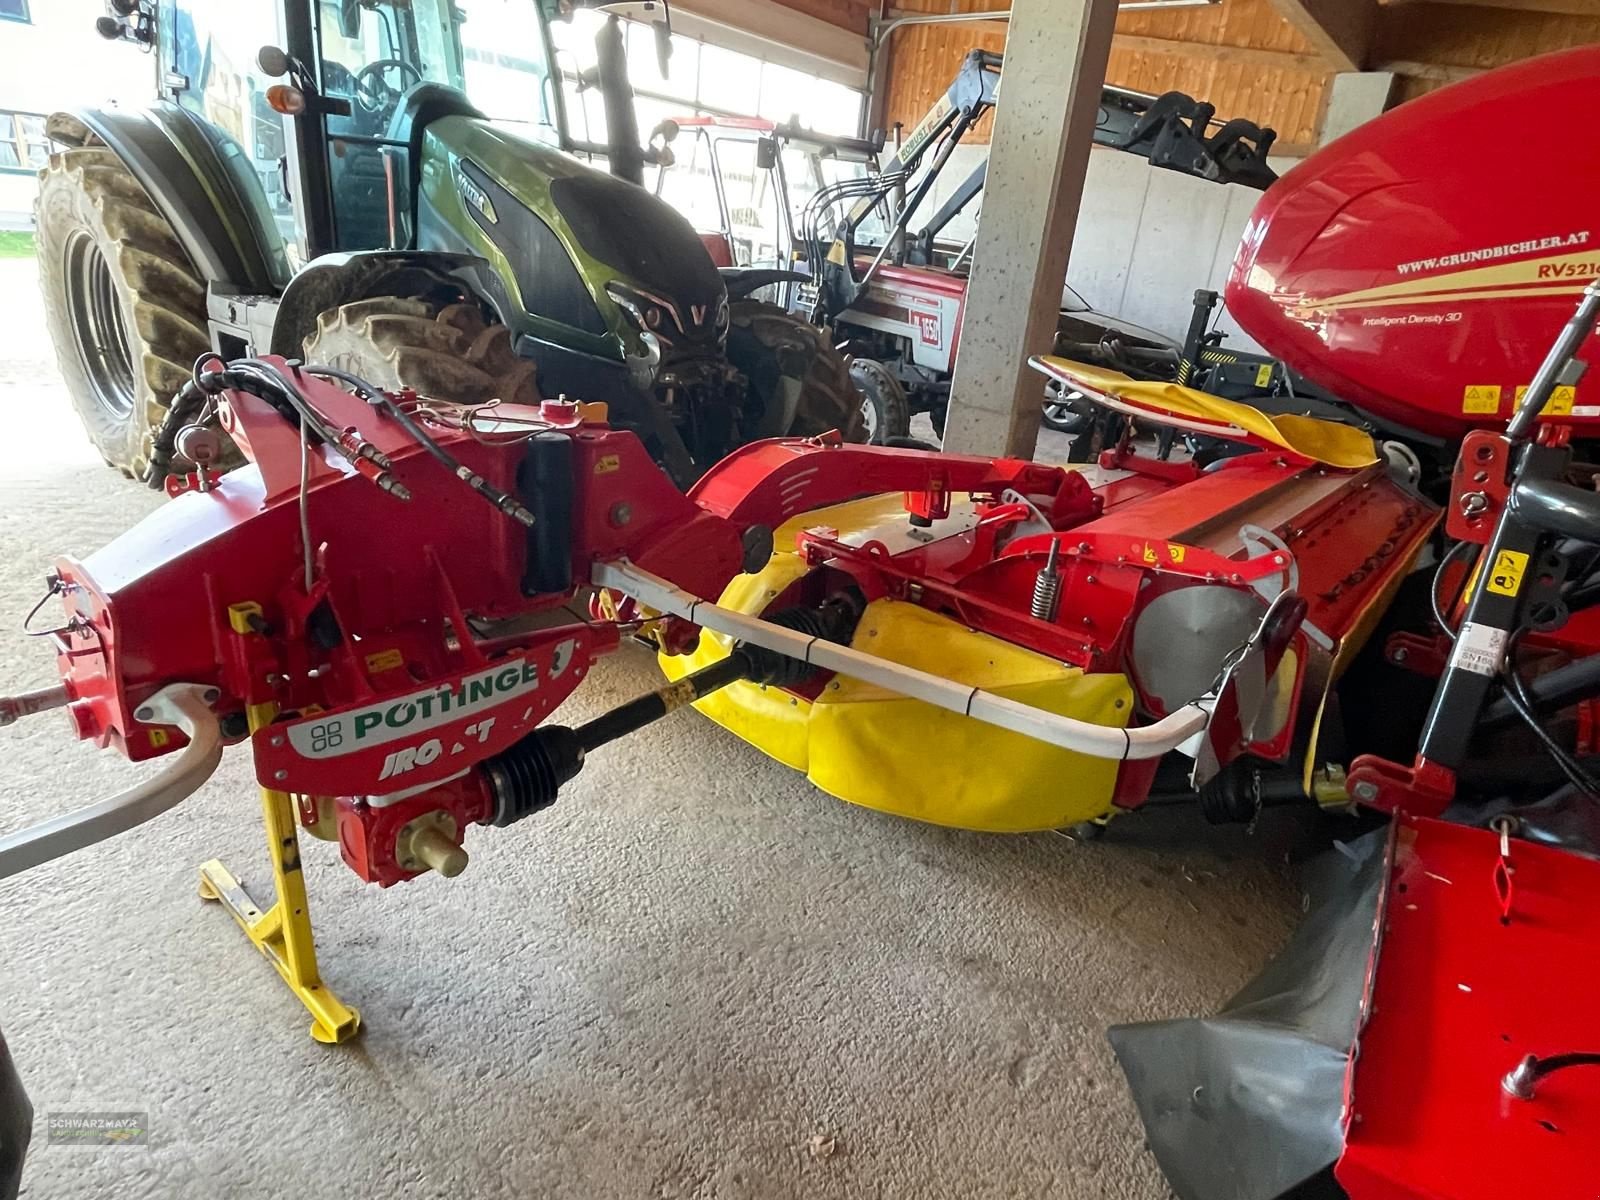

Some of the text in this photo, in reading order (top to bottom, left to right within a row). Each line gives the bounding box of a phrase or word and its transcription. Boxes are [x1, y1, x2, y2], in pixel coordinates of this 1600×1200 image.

[900, 125, 928, 161] ROBUST
[1397, 231, 1589, 274] WWW.GRUNDBICHLER.AT
[1363, 311, 1462, 327] Intelligent Density 3D
